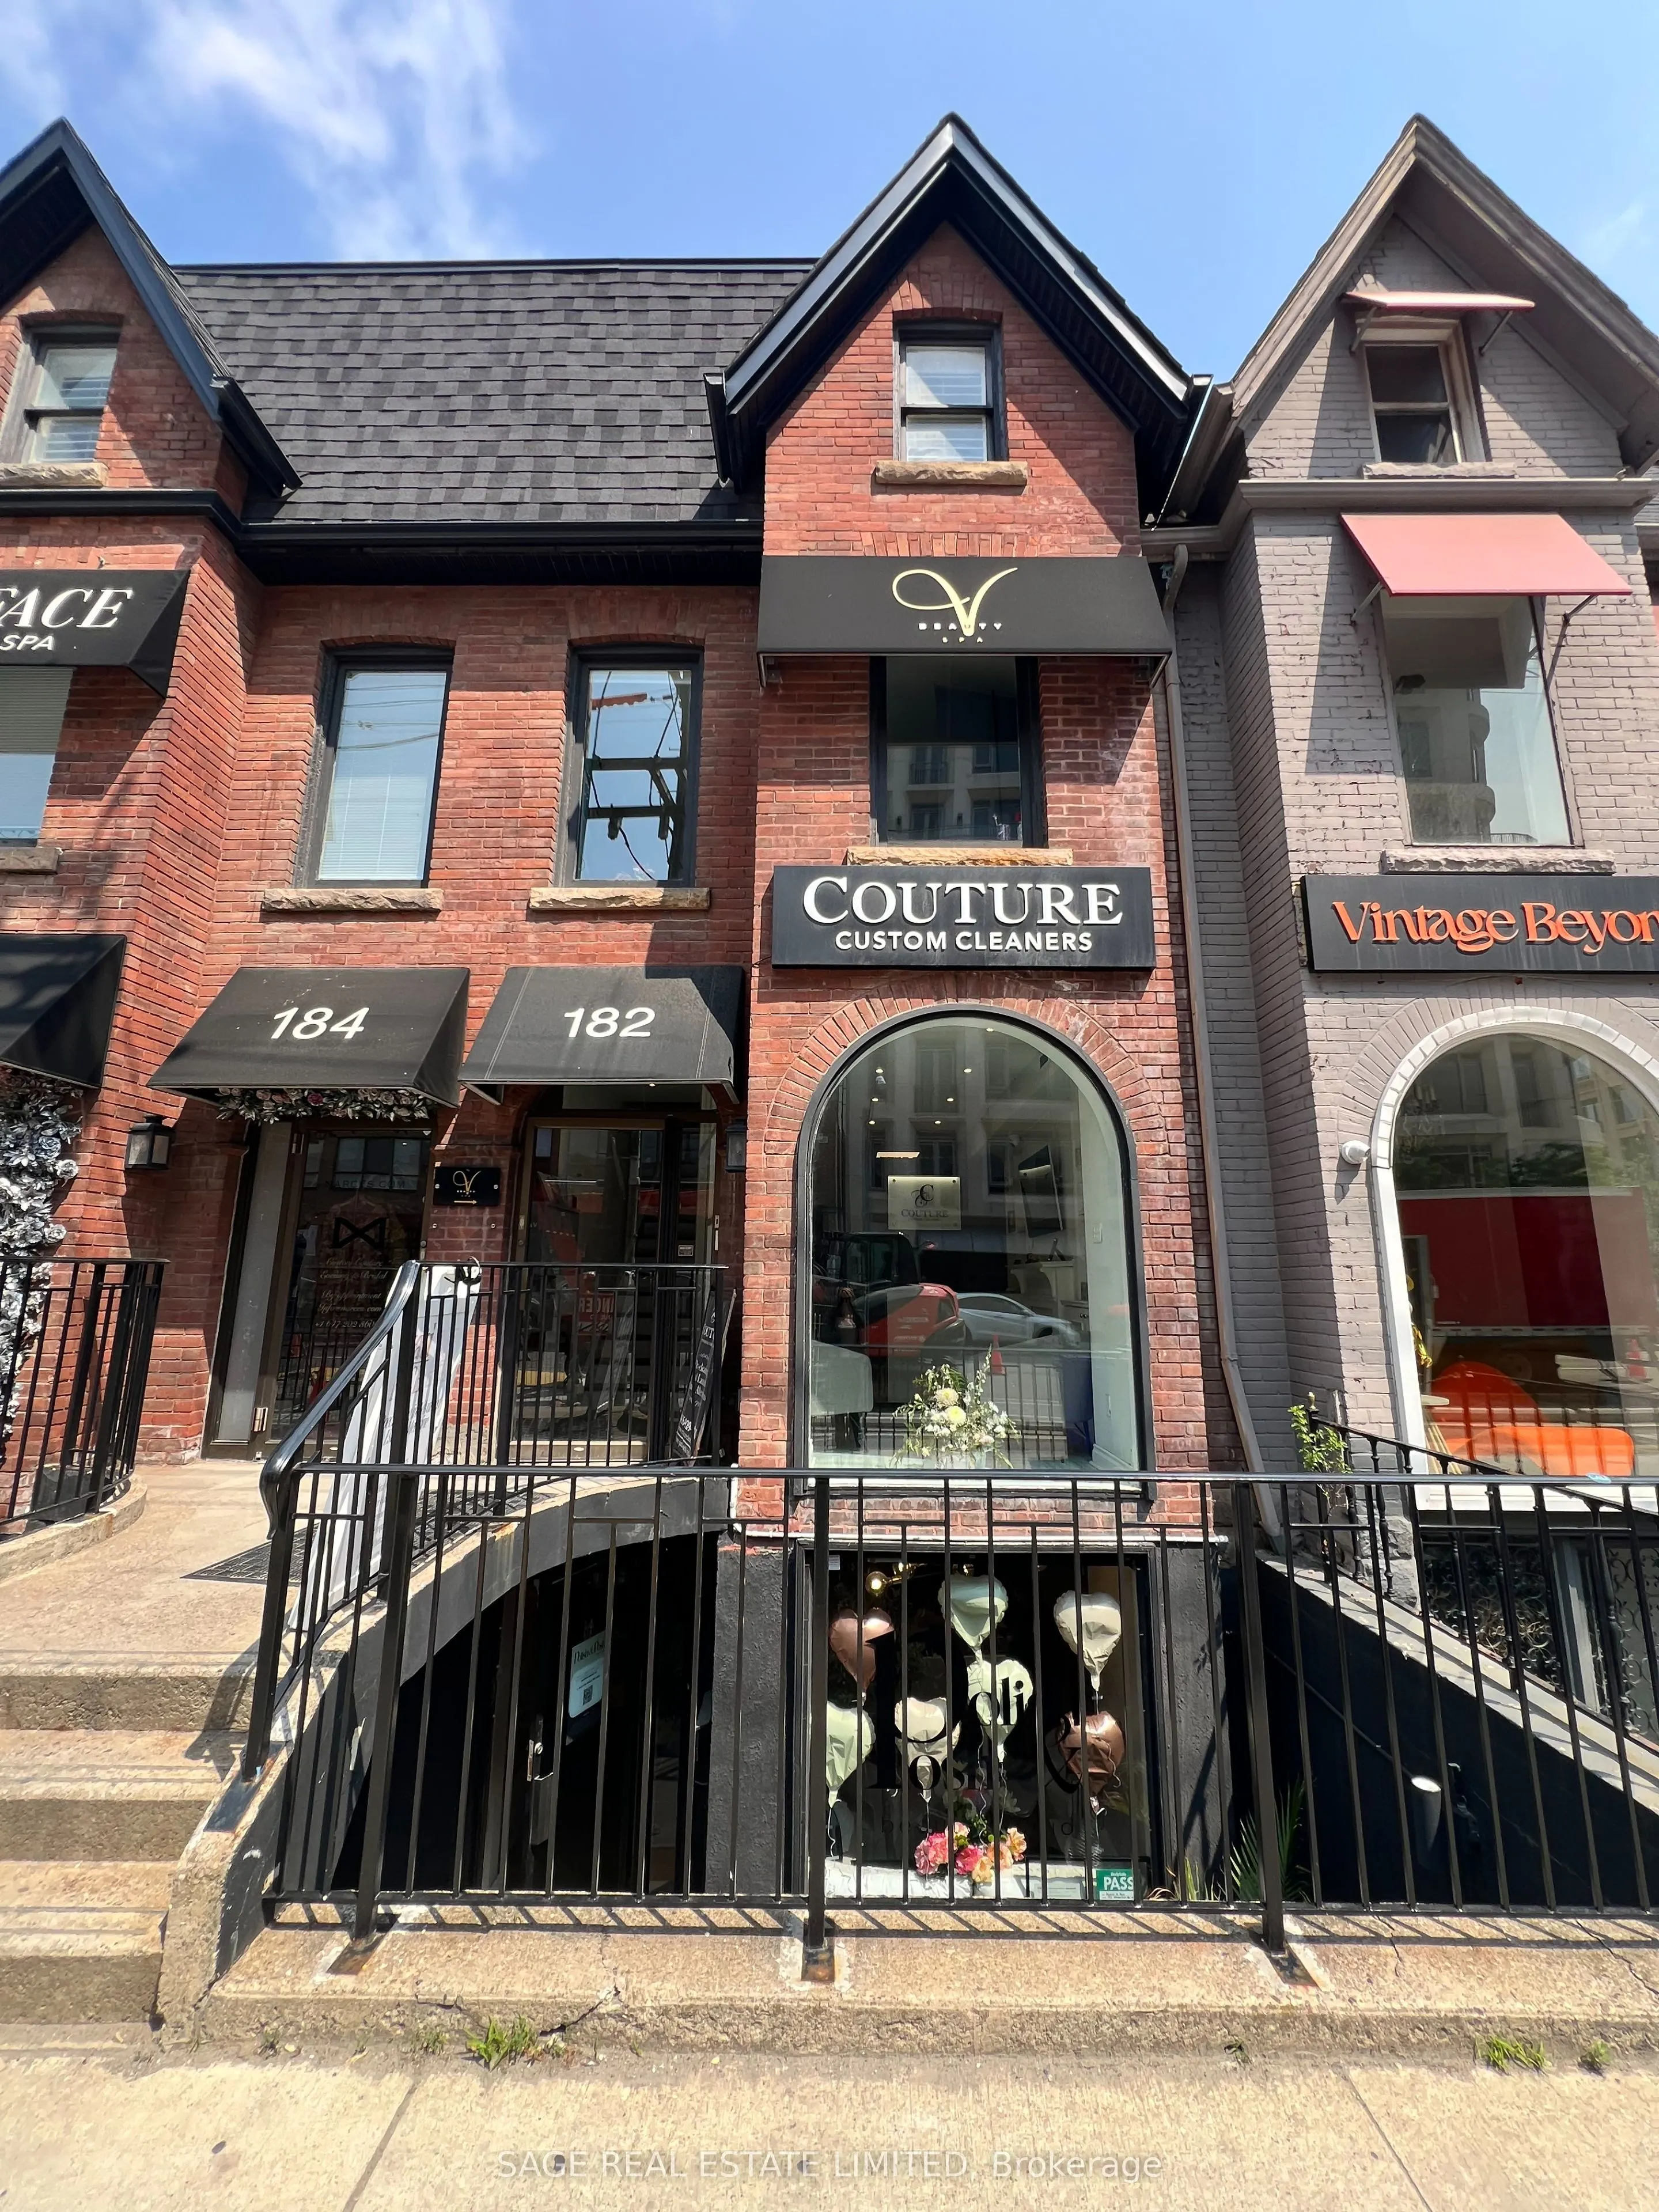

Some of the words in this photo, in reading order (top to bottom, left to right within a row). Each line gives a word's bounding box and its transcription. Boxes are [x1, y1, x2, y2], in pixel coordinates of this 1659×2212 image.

[803, 876, 1123, 926] COUTURE
[835, 930, 947, 952] CUSTOM
[955, 930, 1093, 953] CLEANERS
[1332, 901, 1518, 952] Vintage
[271, 1007, 369, 1039] 184
[564, 1007, 656, 1037] 182
[1104, 1876, 1134, 1890] PASS
